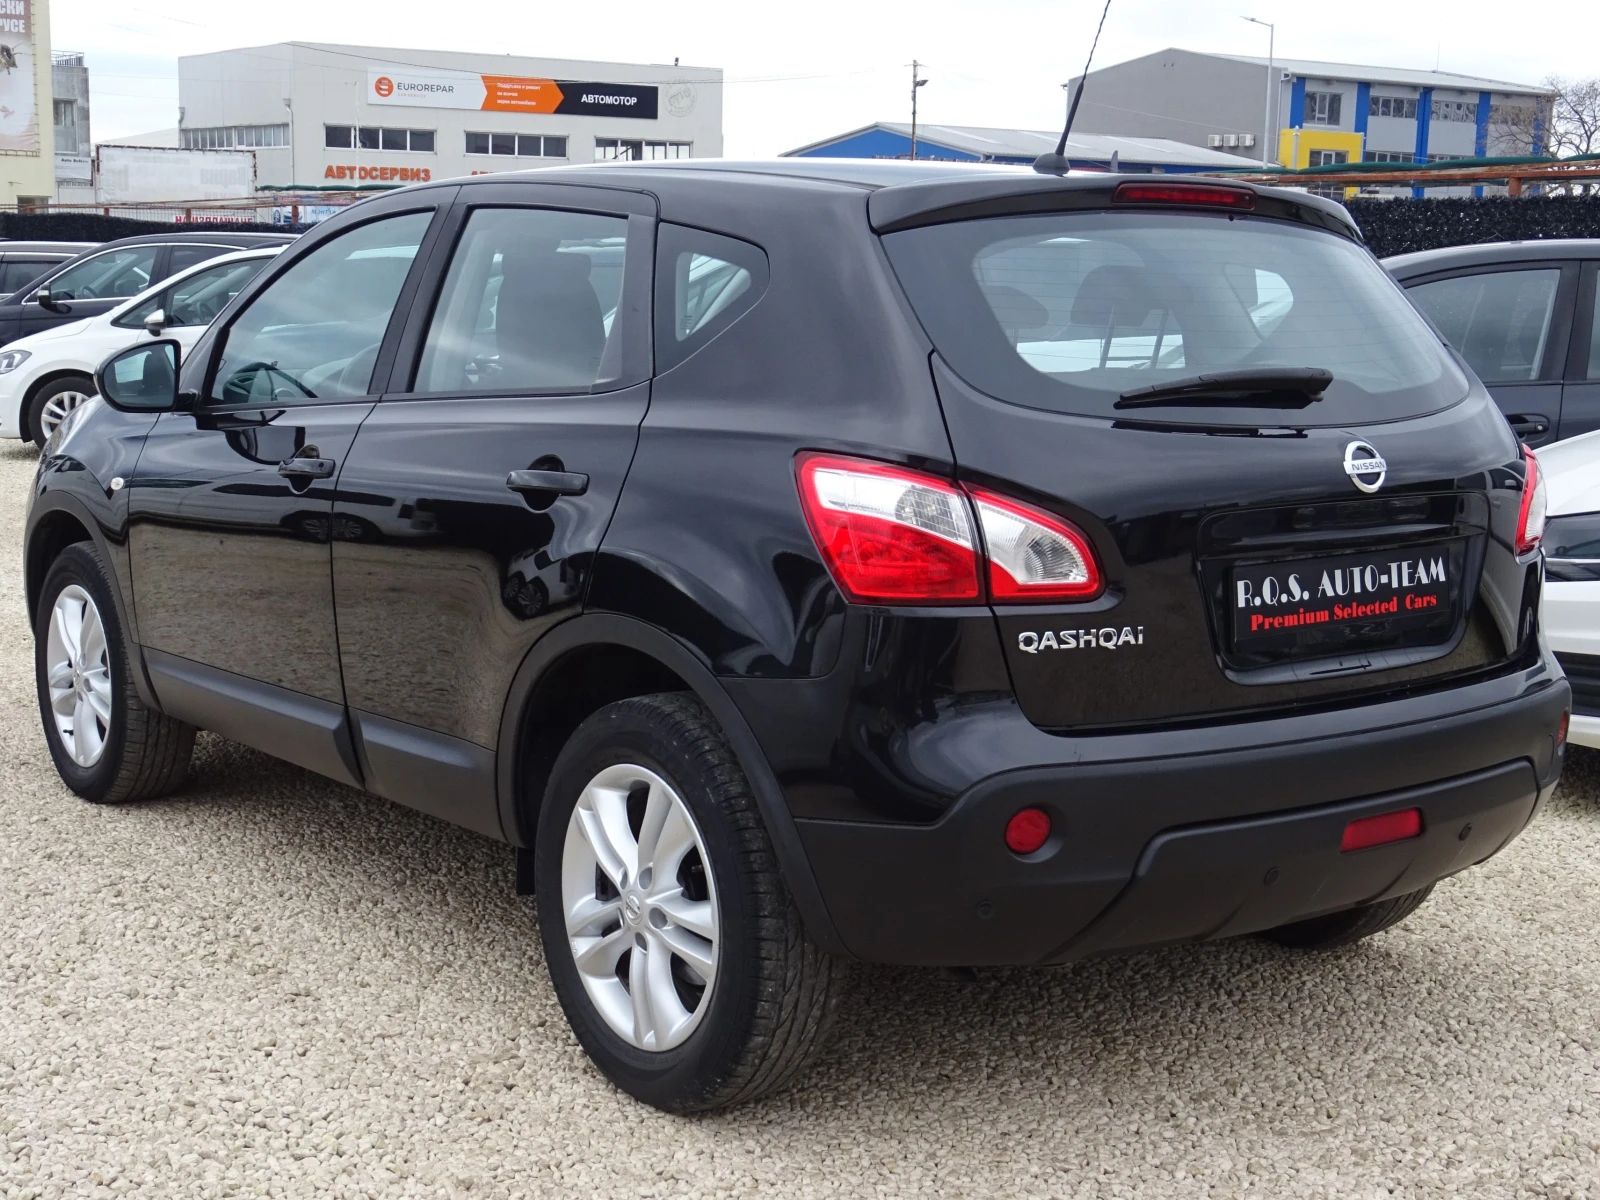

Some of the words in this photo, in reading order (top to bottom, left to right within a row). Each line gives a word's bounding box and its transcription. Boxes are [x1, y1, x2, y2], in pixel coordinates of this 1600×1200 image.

[397, 82, 455, 93] EUROREPAR
[581, 94, 637, 106] АВТОМОТОР
[324, 165, 431, 182] АВТОСЕРВИЗ
[1351, 461, 1385, 471] NISSAN
[1236, 573, 1310, 608] R.Q.S.
[1317, 556, 1446, 598] AUTO-TEAM
[1250, 608, 1330, 631] Premium
[1333, 596, 1398, 621] Selected
[1404, 593, 1438, 610] Cars
